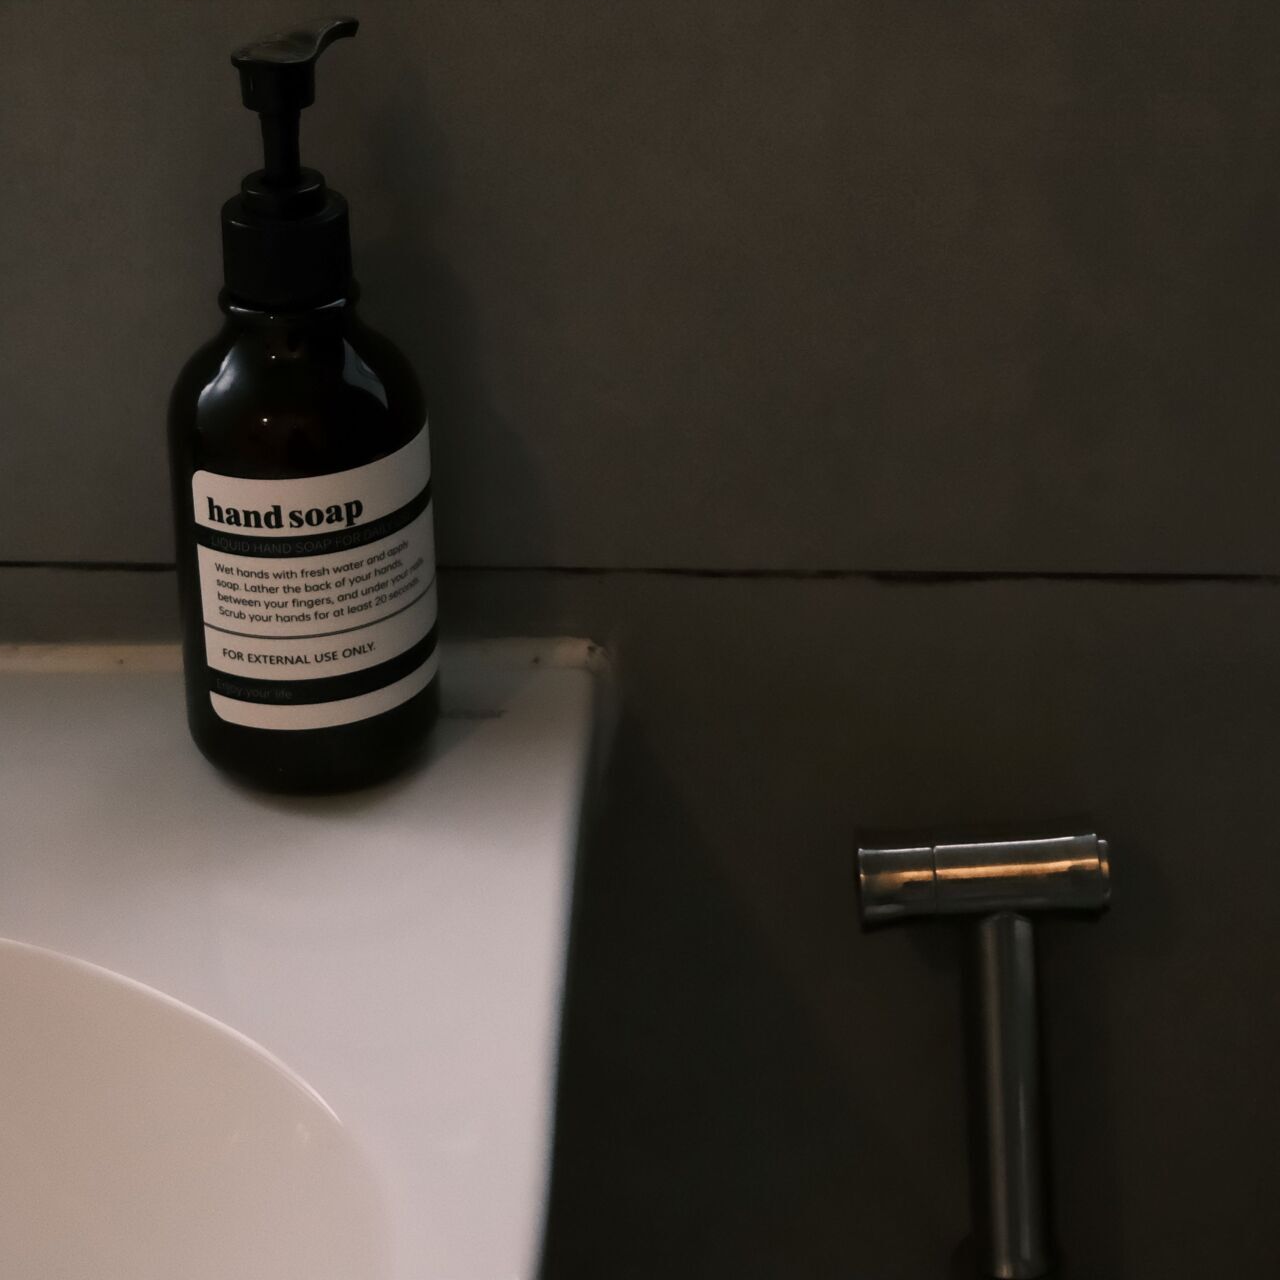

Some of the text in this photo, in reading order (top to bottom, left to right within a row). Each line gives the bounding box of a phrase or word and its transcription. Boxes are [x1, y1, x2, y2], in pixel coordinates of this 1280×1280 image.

[206, 496, 285, 529] hand
[288, 499, 363, 528] soap
[210, 535, 250, 553] LIQUID
[253, 542, 292, 554] HAND
[295, 538, 332, 554] SOAP
[335, 531, 361, 548] FOR
[215, 540, 409, 579] Wet hands with fresh water and apply
[216, 578, 239, 591] soap.
[244, 583, 279, 594] Lather
[283, 585, 301, 593] the
[304, 581, 332, 593] back
[335, 578, 347, 589] of
[349, 572, 372, 587] your
[217, 591, 261, 608] between
[264, 600, 288, 610] your
[292, 596, 335, 610] fingers,
[337, 589, 358, 602] and
[361, 580, 388, 596] under
[390, 569, 409, 586] your
[219, 606, 246, 620] Scrub
[249, 613, 272, 623] your
[276, 611, 311, 623] hands
[314, 610, 330, 620] for
[333, 607, 345, 618] at
[347, 600, 372, 615] least
[375, 594, 387, 607] 20
[222, 641, 376, 665] FOR EXTERNAL USE ONLY.
